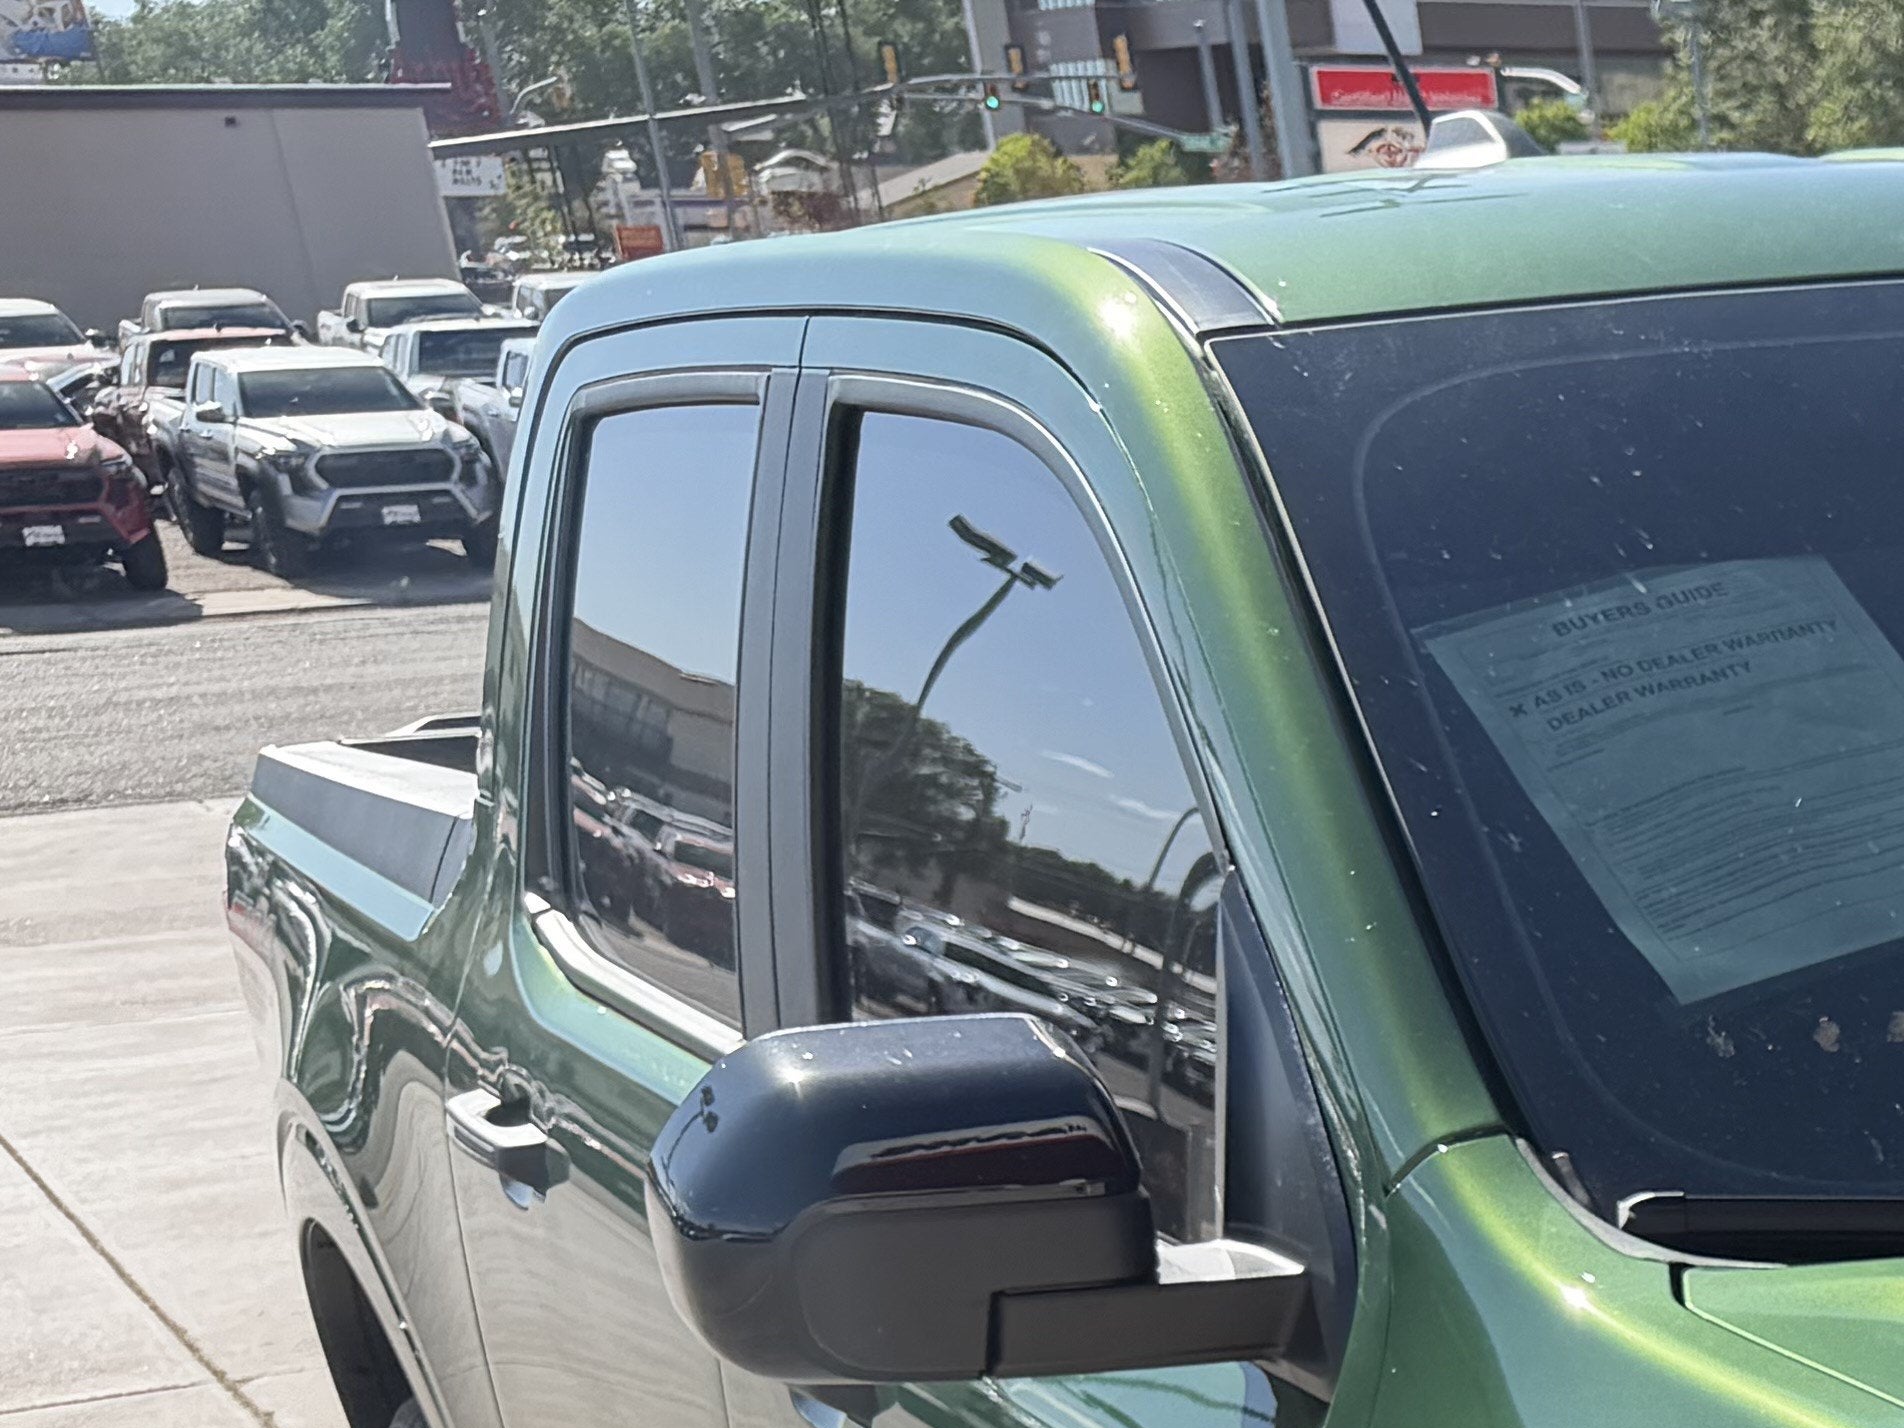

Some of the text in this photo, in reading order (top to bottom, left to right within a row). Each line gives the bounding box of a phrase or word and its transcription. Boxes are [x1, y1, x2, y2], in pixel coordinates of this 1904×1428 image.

[1551, 581, 1730, 638] BUYERS GUIDE
[1600, 663, 1635, 685] NO
[1636, 642, 1719, 674] DEALER
[1720, 618, 1838, 652] WARRANTY
[1547, 660, 1753, 733] DEALER WARRANTY
